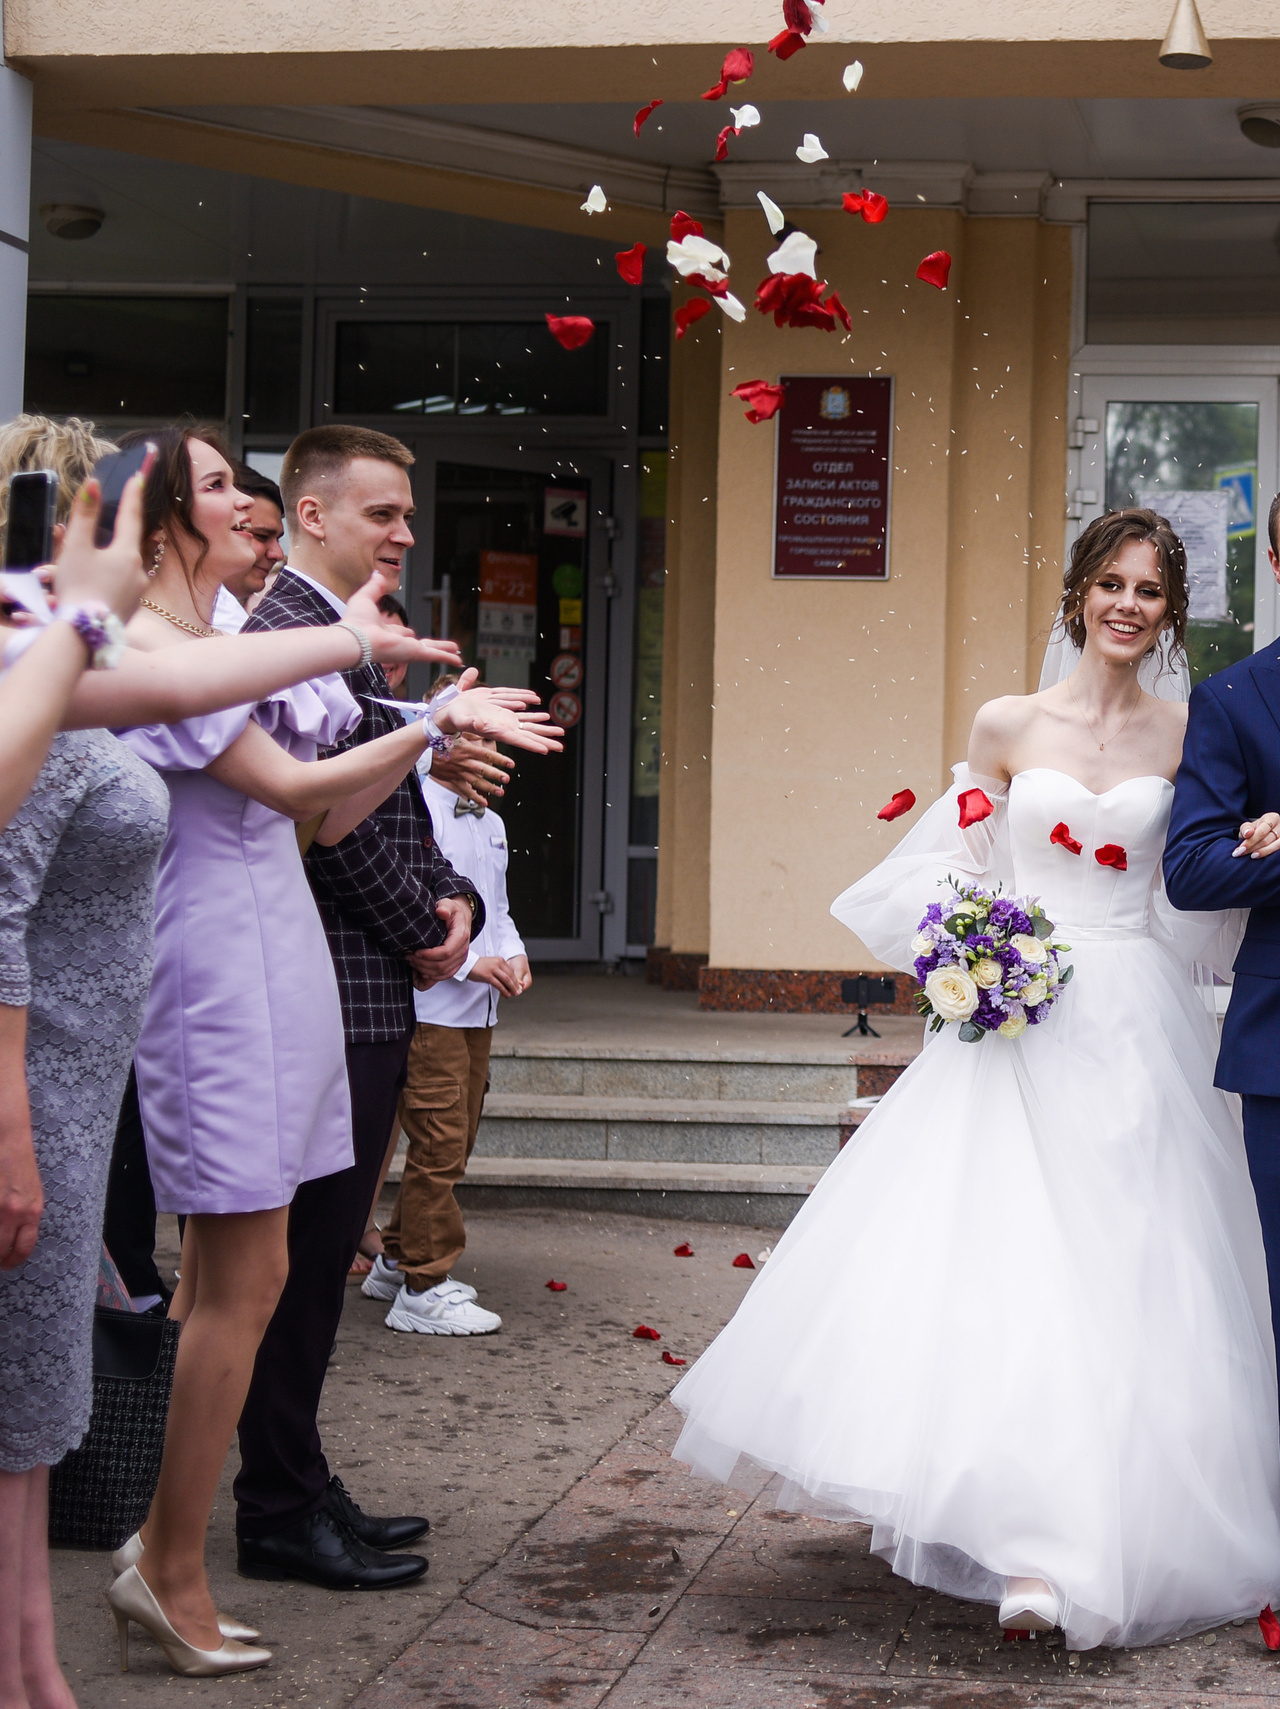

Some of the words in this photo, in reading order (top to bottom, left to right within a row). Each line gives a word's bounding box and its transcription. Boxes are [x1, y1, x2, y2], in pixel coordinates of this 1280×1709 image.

[812, 462, 854, 473] ОТДЕЛ
[786, 478, 836, 490] ЗАПИСИ
[838, 479, 880, 491] АКТОВ
[783, 496, 882, 508] ГРАЖДАНСКОГО
[793, 514, 869, 526] СОСТОЯНИЯ
